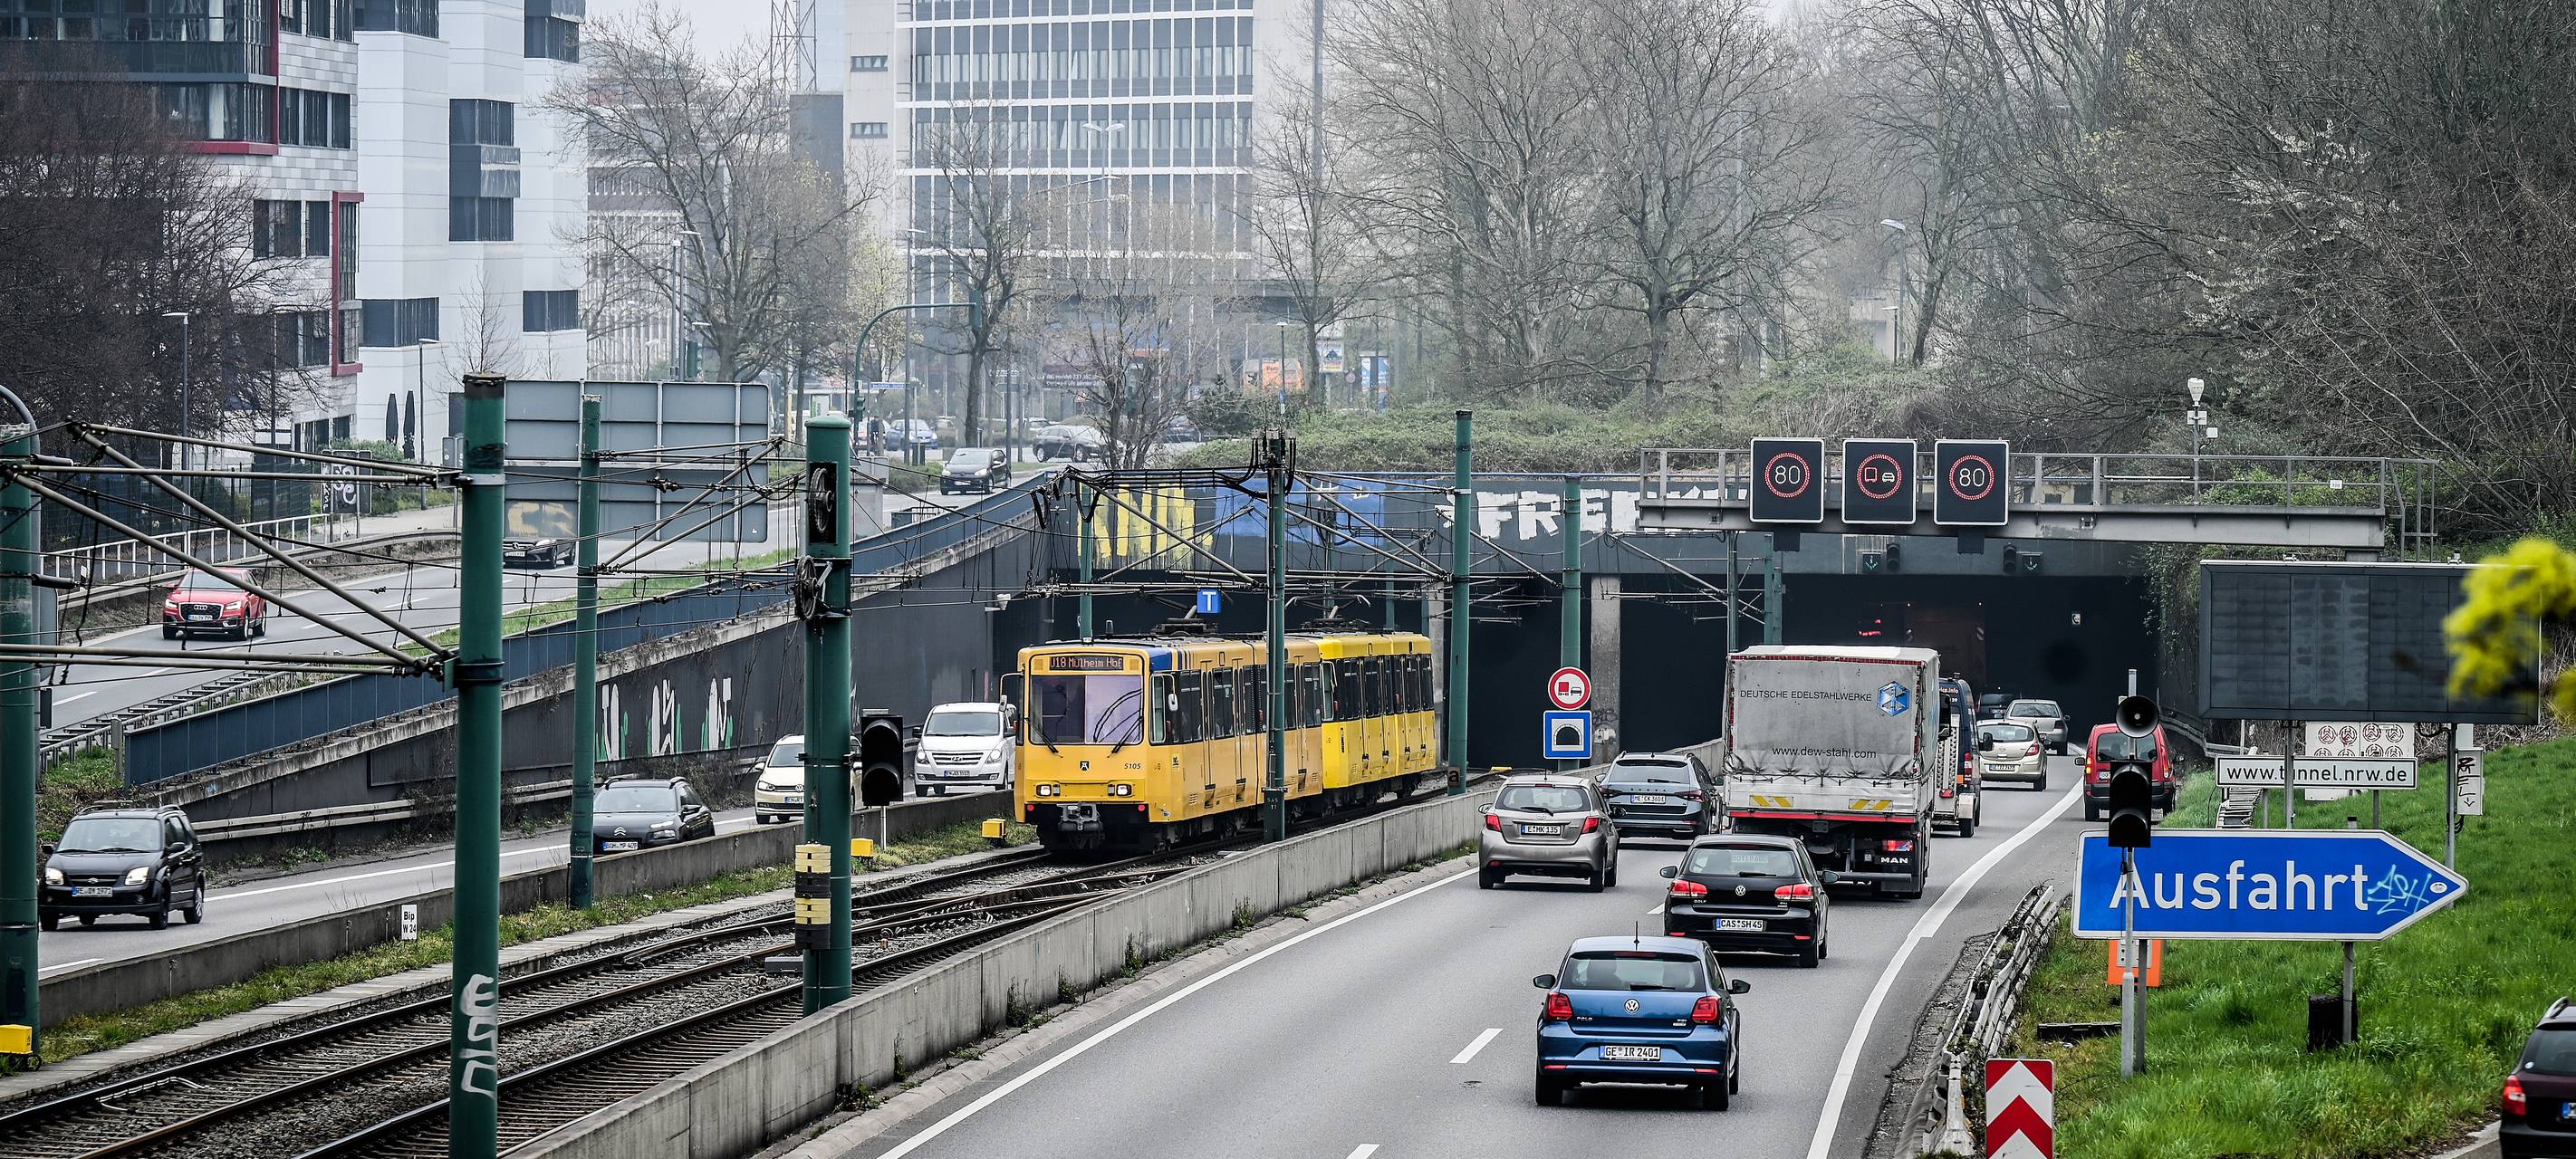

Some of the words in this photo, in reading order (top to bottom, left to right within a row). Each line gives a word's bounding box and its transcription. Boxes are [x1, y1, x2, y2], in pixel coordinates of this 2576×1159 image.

[1774, 465, 1801, 484] 80
[1959, 467, 1985, 487] 80
[1202, 591, 1216, 611] T
[1740, 690, 1788, 699] DEUTSCHE
[1791, 691, 1872, 702] EDELSTAHLWERKE
[1772, 746, 1877, 759] www.dew-stahl.com
[2227, 765, 2408, 782] www.tnnel.nrw.de
[2109, 859, 2369, 911] Ausfahrt
[404, 912, 415, 922] Bip
[403, 924, 409, 934] W
[409, 924, 417, 934] 24
[1637, 1047, 1659, 1058] 2401
